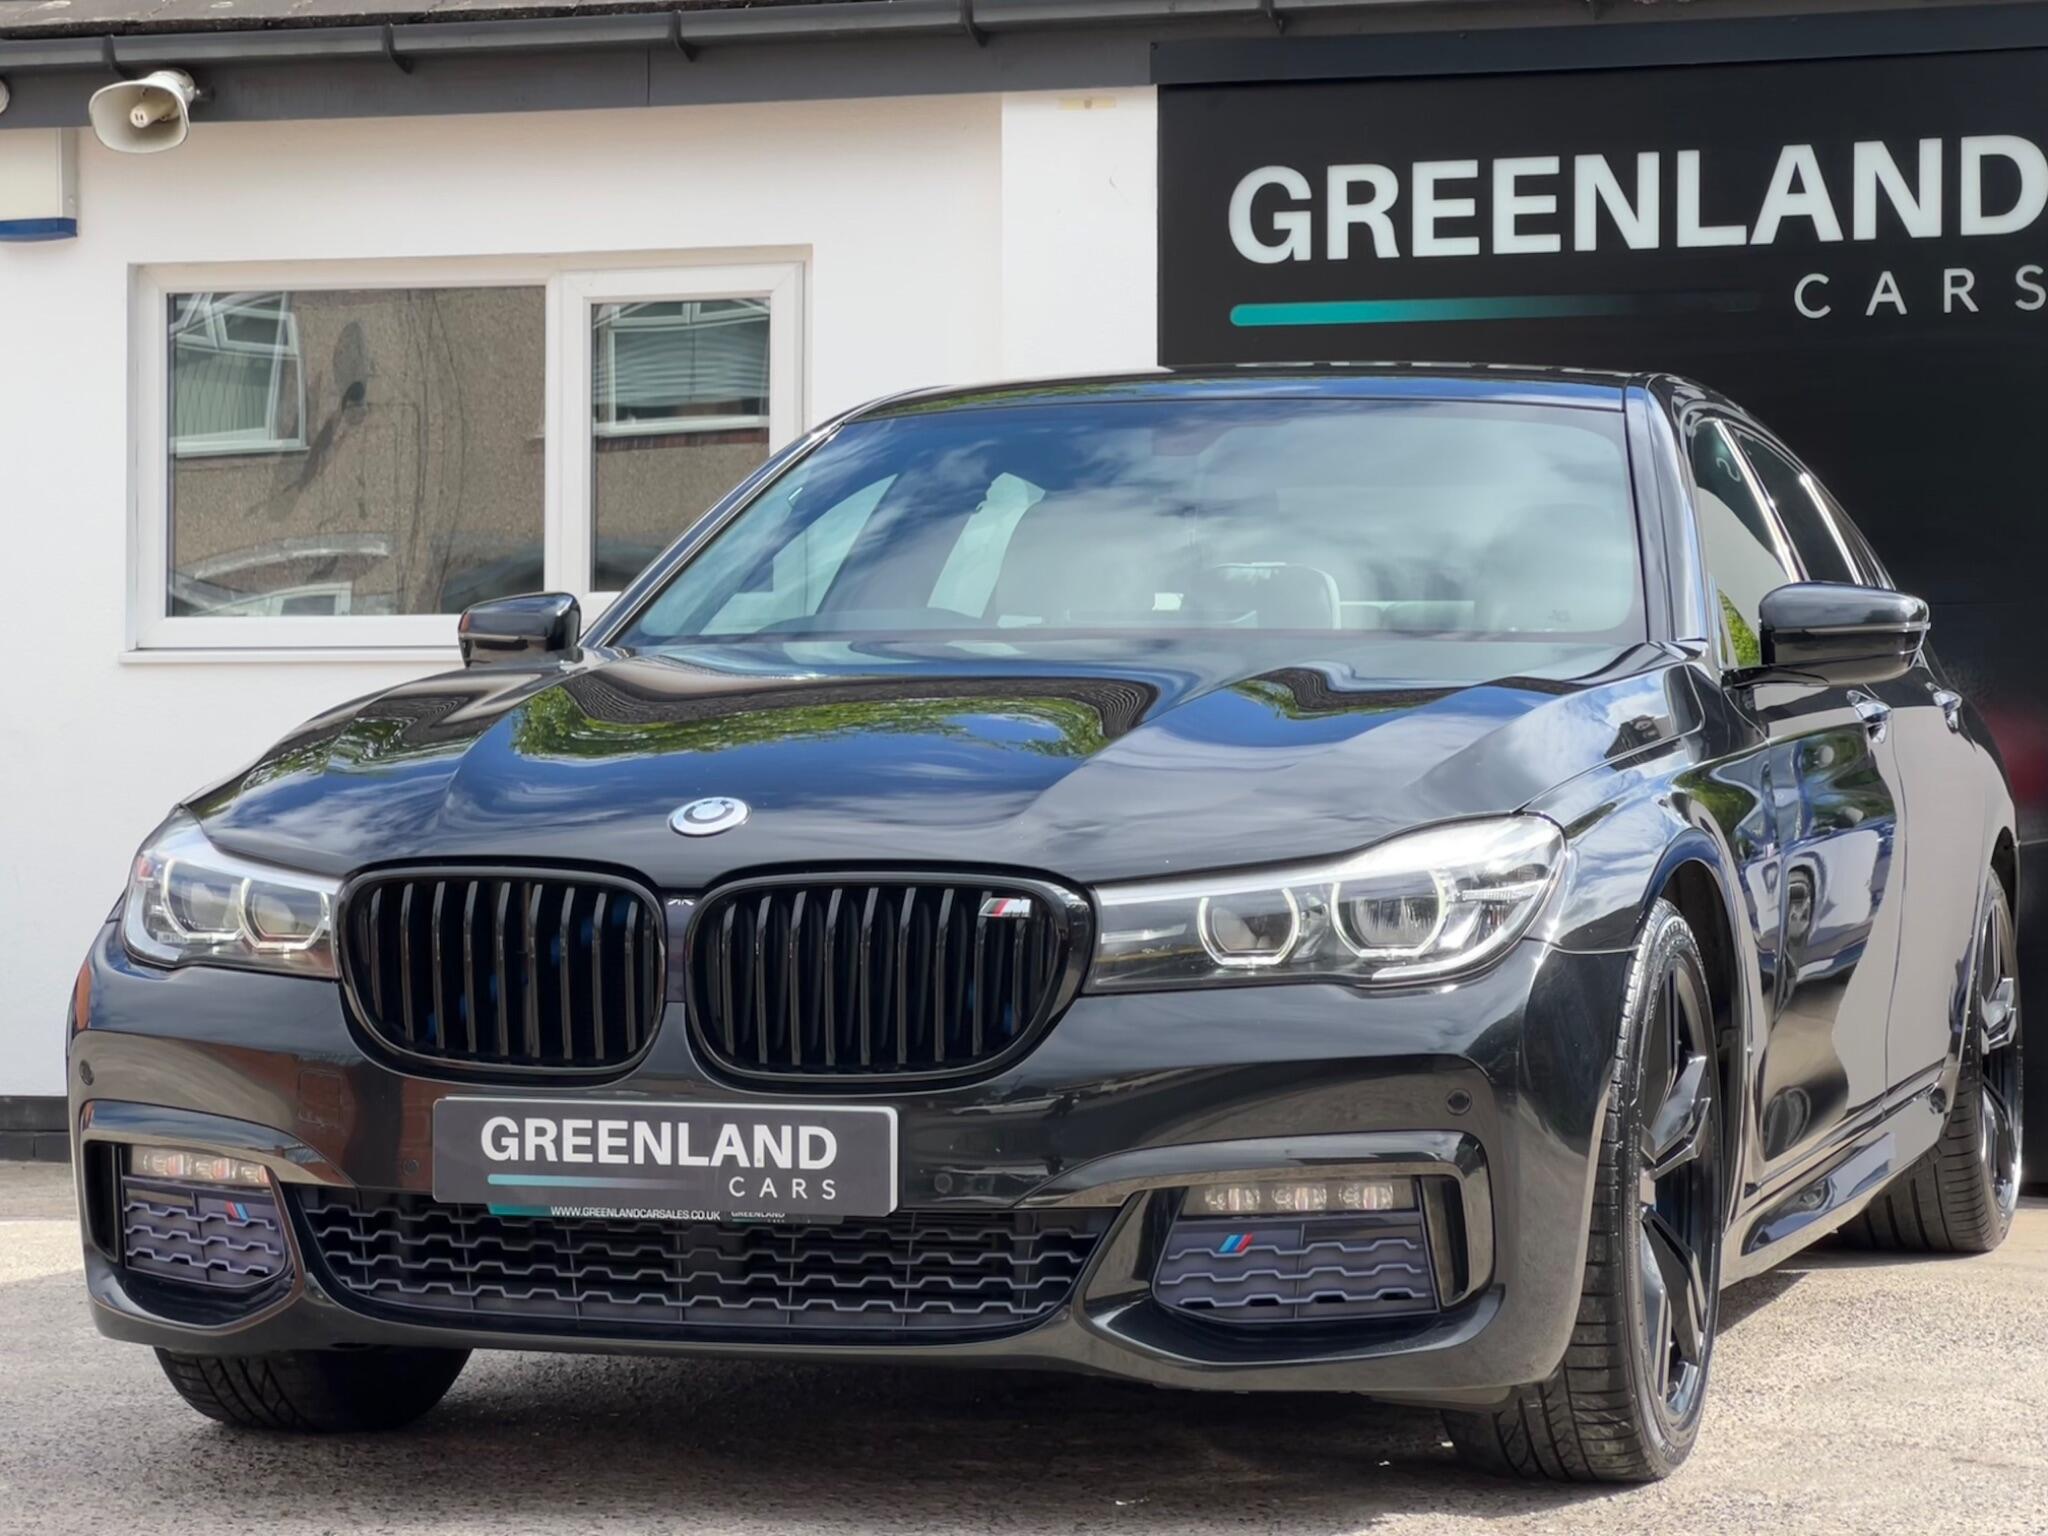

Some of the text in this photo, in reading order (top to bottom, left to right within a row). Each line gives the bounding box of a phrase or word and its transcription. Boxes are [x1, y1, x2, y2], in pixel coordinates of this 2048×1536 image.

[1228, 134, 2048, 265] GREENLAND
[1794, 264, 2047, 319] CARS
[480, 1116, 838, 1170] GREENLAND
[550, 1206, 721, 1221] WWW.GREENLANDCARSALES.CO.UK
[728, 1176, 836, 1201] CARS
